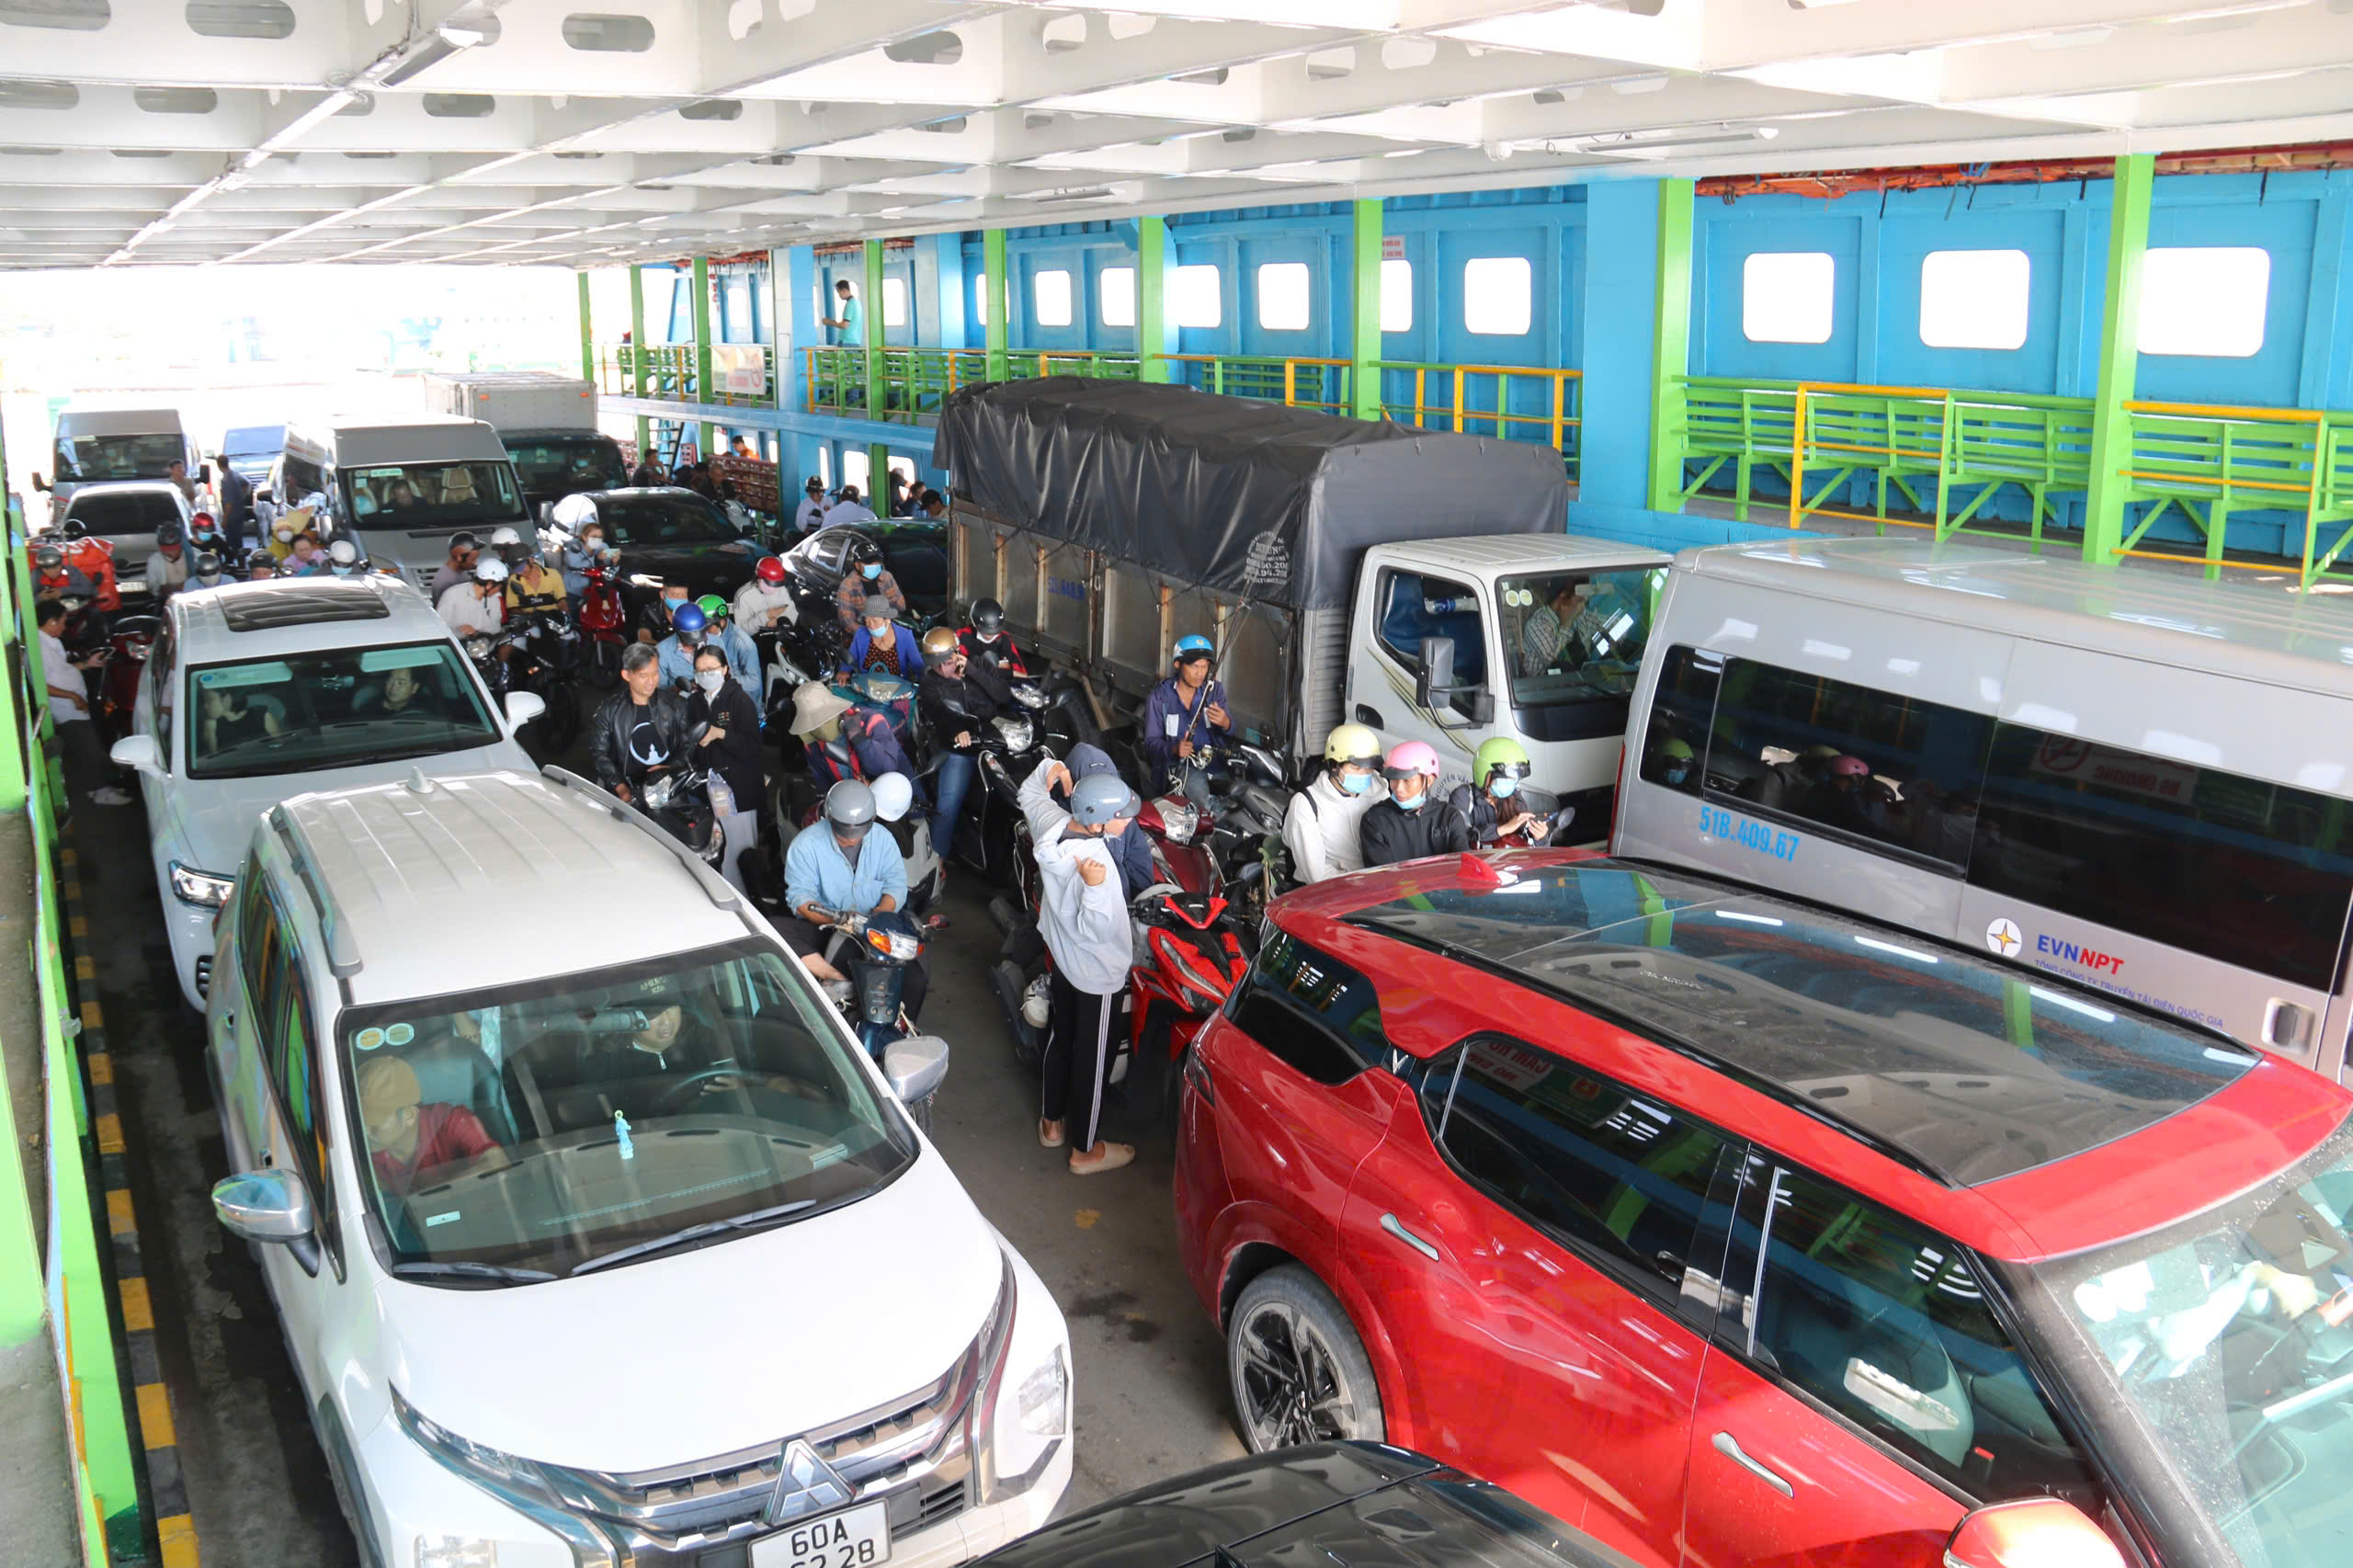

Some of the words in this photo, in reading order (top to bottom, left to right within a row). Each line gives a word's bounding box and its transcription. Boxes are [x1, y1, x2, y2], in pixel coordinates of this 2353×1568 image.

[1699, 805, 1801, 862] 51B.409.67
[2037, 934, 2126, 975] EVNNPT
[2207, 1015, 2223, 1028] GIA
[791, 1517, 847, 1556] 60A
